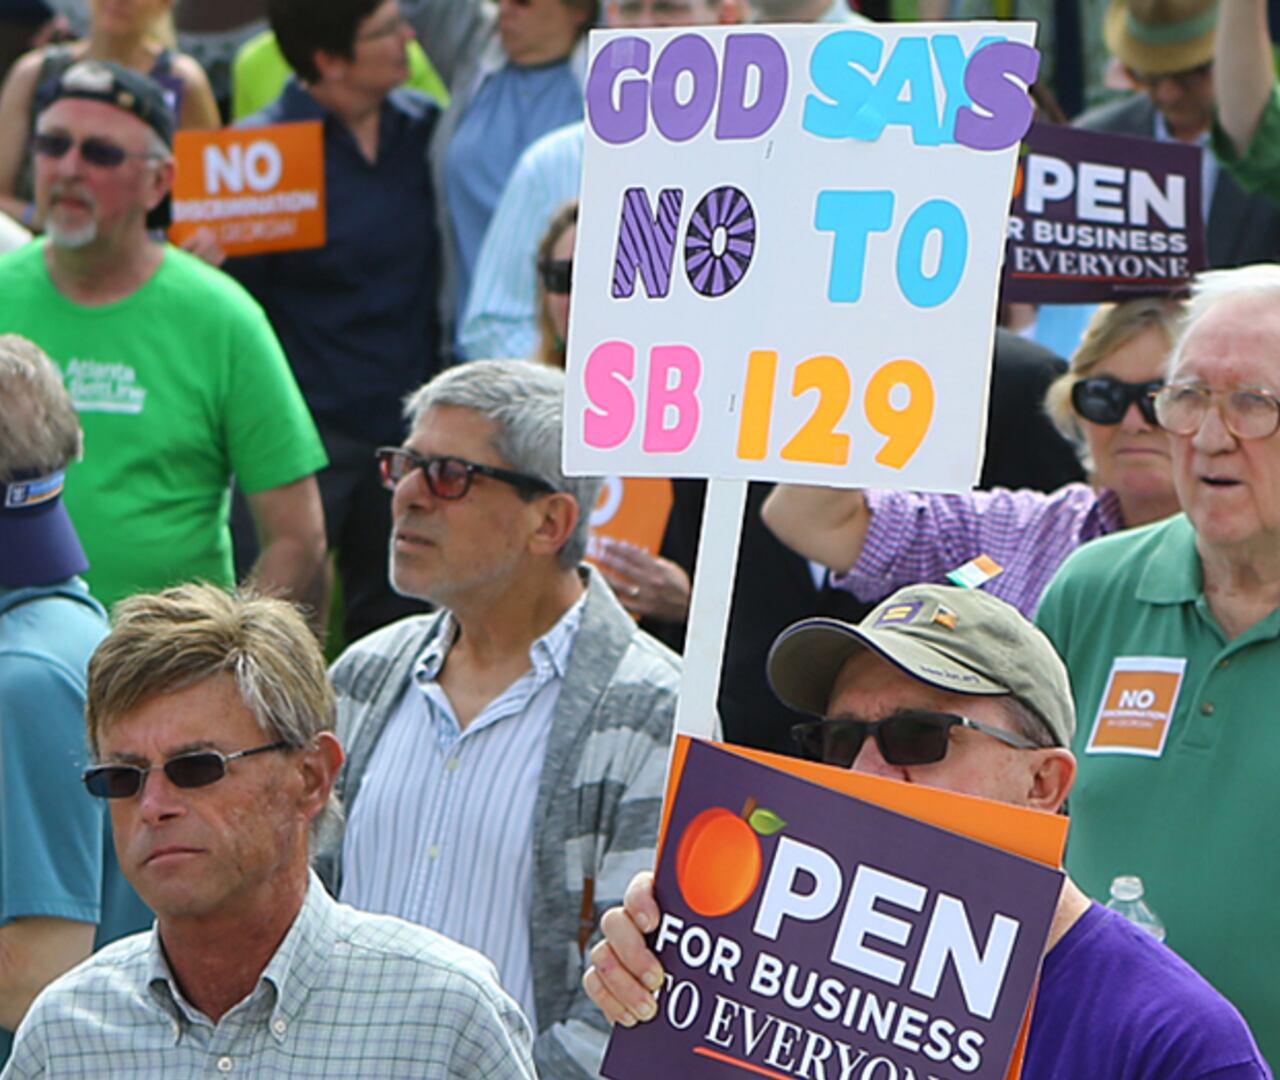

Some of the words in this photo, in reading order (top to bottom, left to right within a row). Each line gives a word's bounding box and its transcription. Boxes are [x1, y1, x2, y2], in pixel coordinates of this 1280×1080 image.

[586, 32, 789, 145] GOD
[802, 29, 1042, 151] SAYS
[203, 139, 283, 195] NO
[610, 185, 757, 300] NO
[814, 189, 969, 309] TO
[1013, 246, 1190, 279] EVERYONE
[1032, 219, 1188, 254] BUSINESS
[583, 340, 701, 454] SB
[736, 350, 935, 470] 129
[1118, 688, 1156, 709] NO
[655, 914, 742, 983] FOR
[750, 952, 986, 1073] BUSINESS
